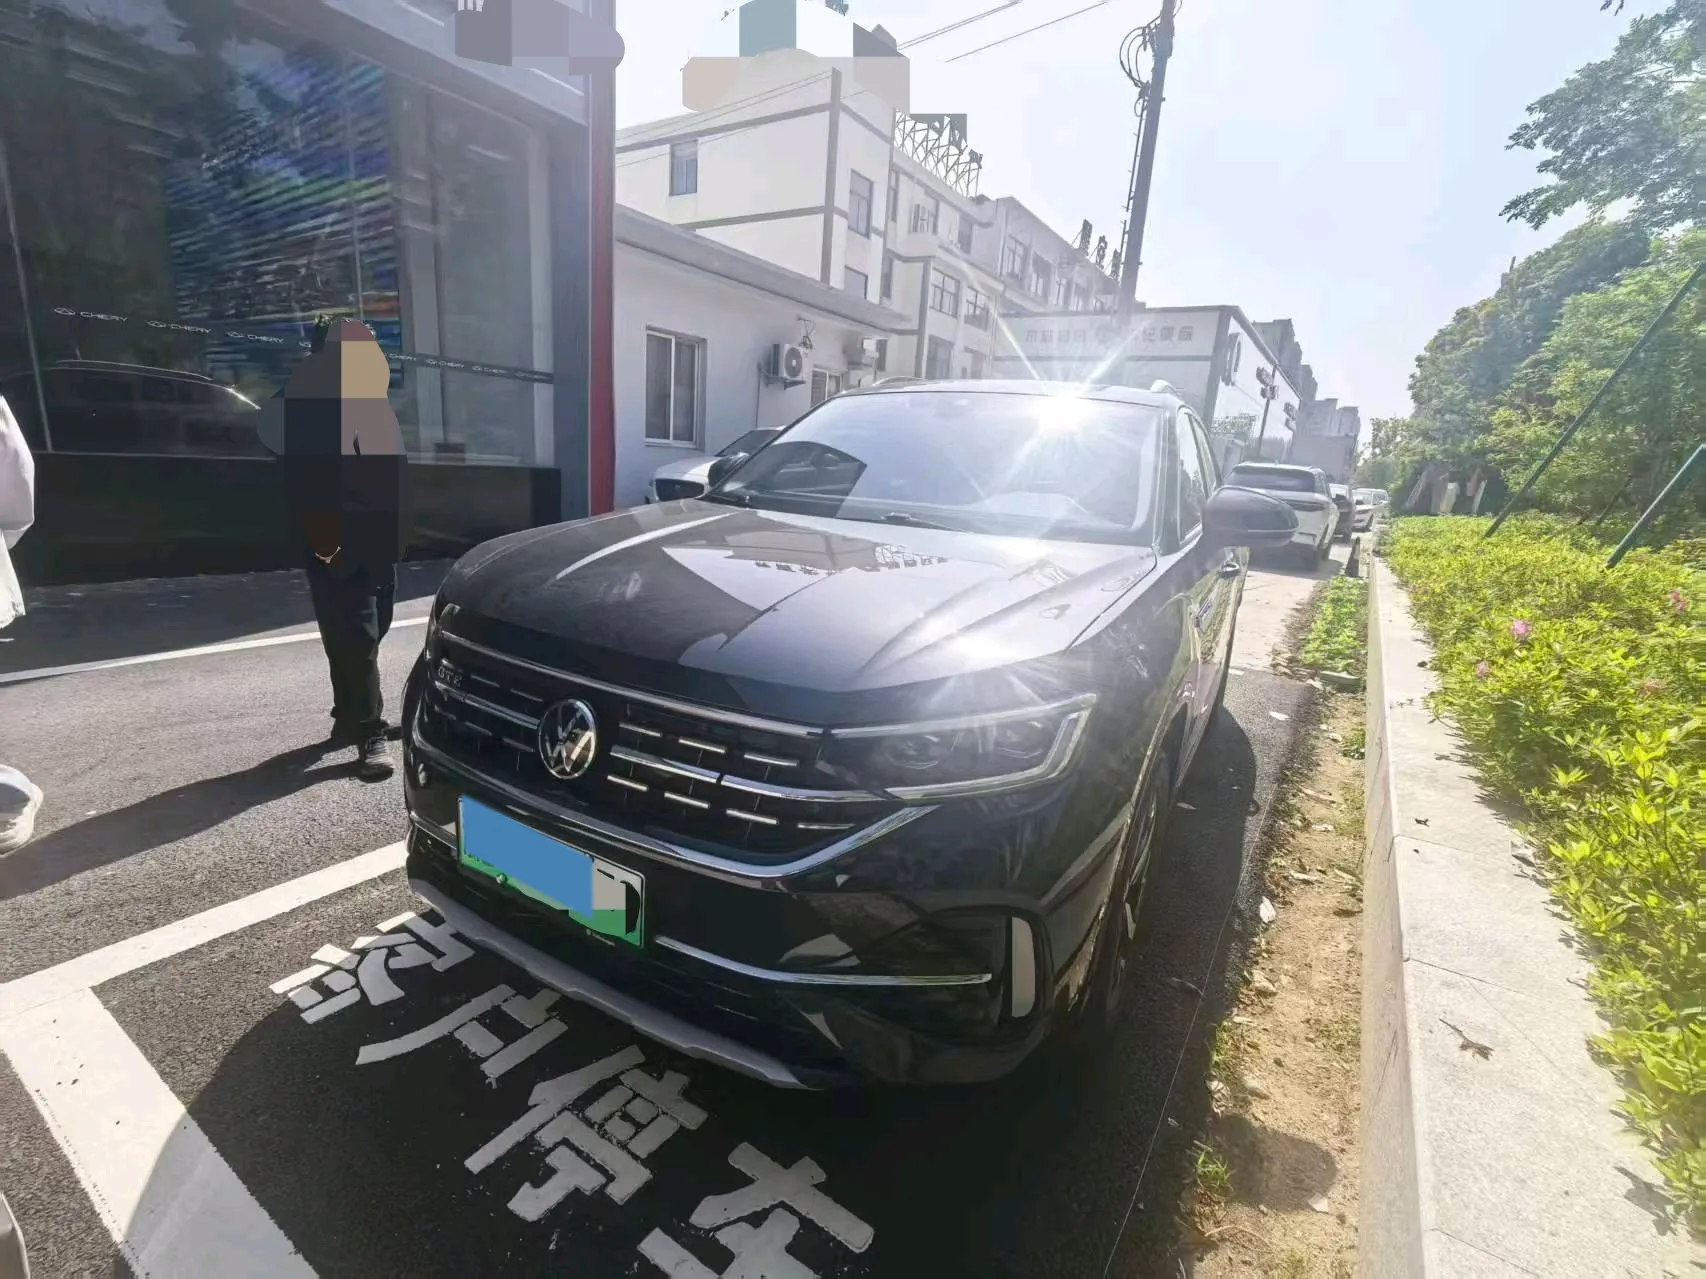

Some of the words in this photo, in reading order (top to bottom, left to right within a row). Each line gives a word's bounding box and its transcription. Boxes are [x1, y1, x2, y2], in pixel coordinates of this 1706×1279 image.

[79, 311, 128, 322] CHERY
[169, 323, 212, 334] CHERY
[247, 333, 285, 345] CHERY
